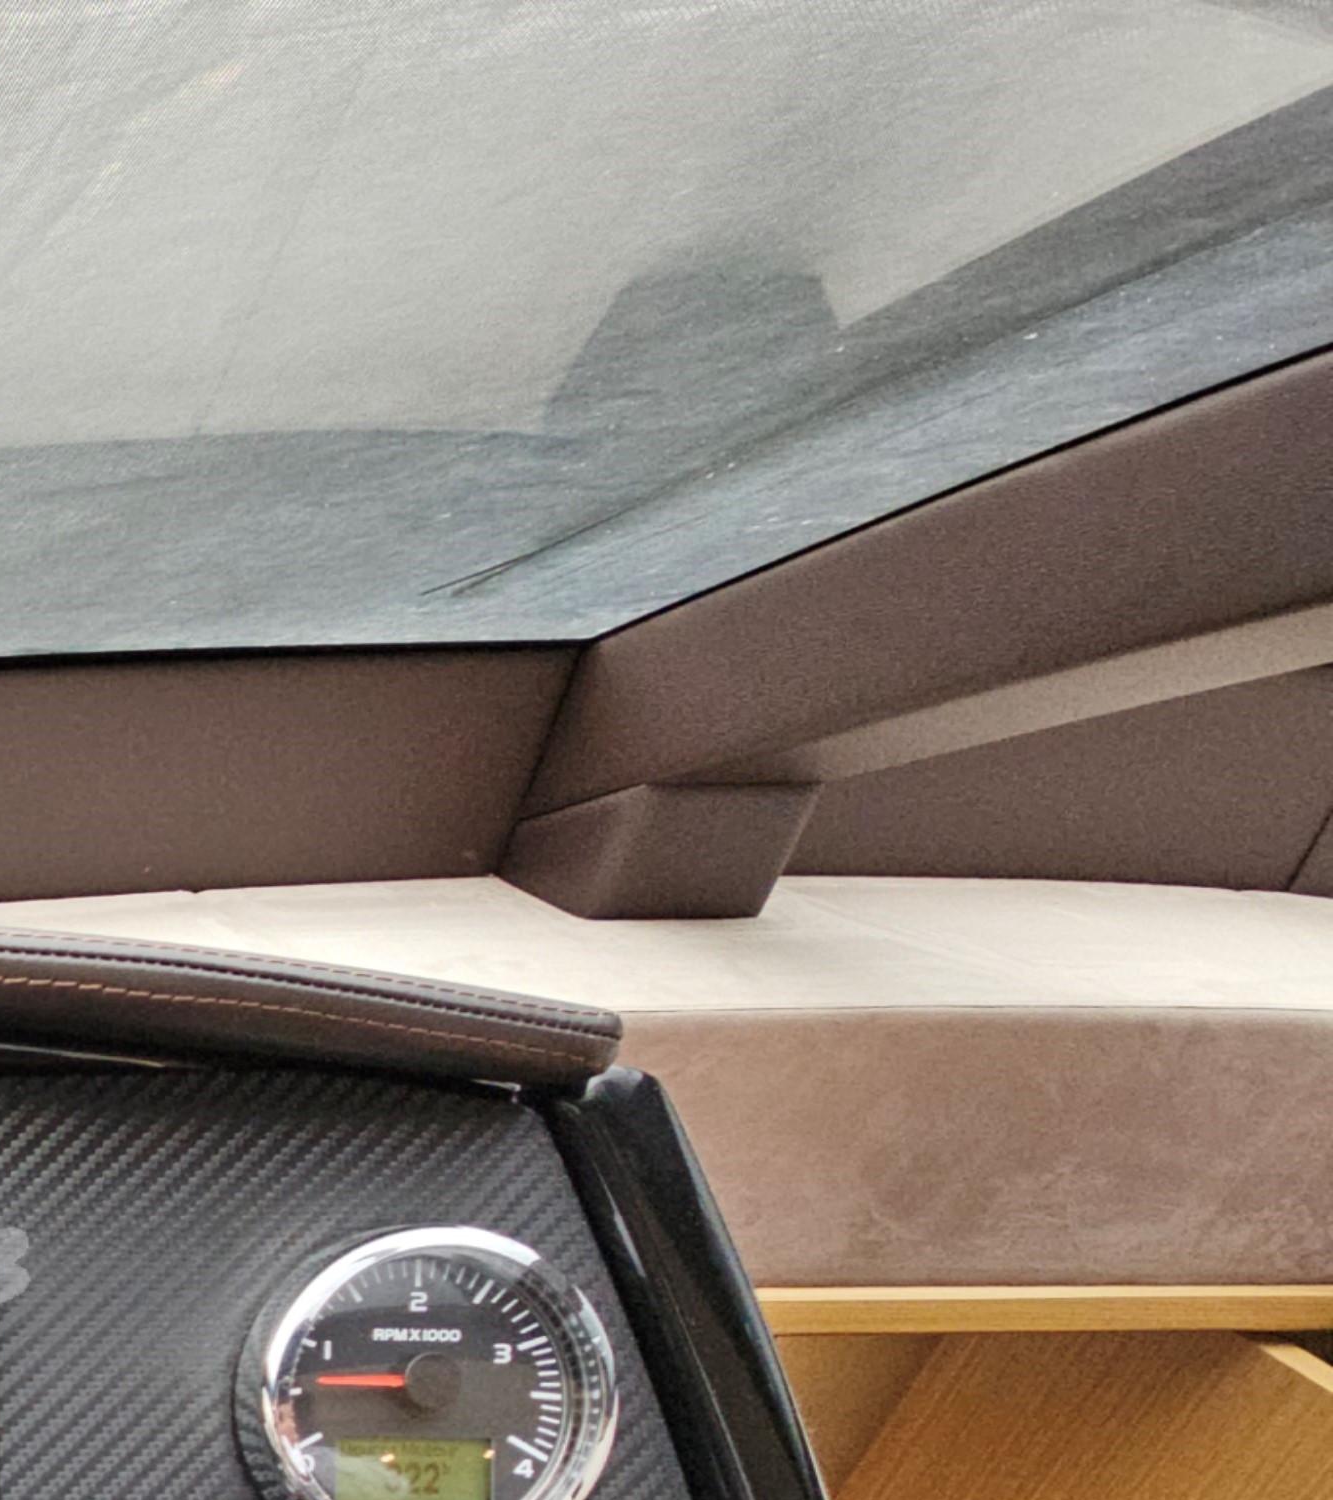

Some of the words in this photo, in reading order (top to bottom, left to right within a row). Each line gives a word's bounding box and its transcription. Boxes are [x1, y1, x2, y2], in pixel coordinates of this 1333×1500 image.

[409, 1292, 428, 1313] 2
[322, 1342, 331, 1361] 1
[492, 1343, 512, 1365] 3
[513, 1458, 534, 1479] 4
